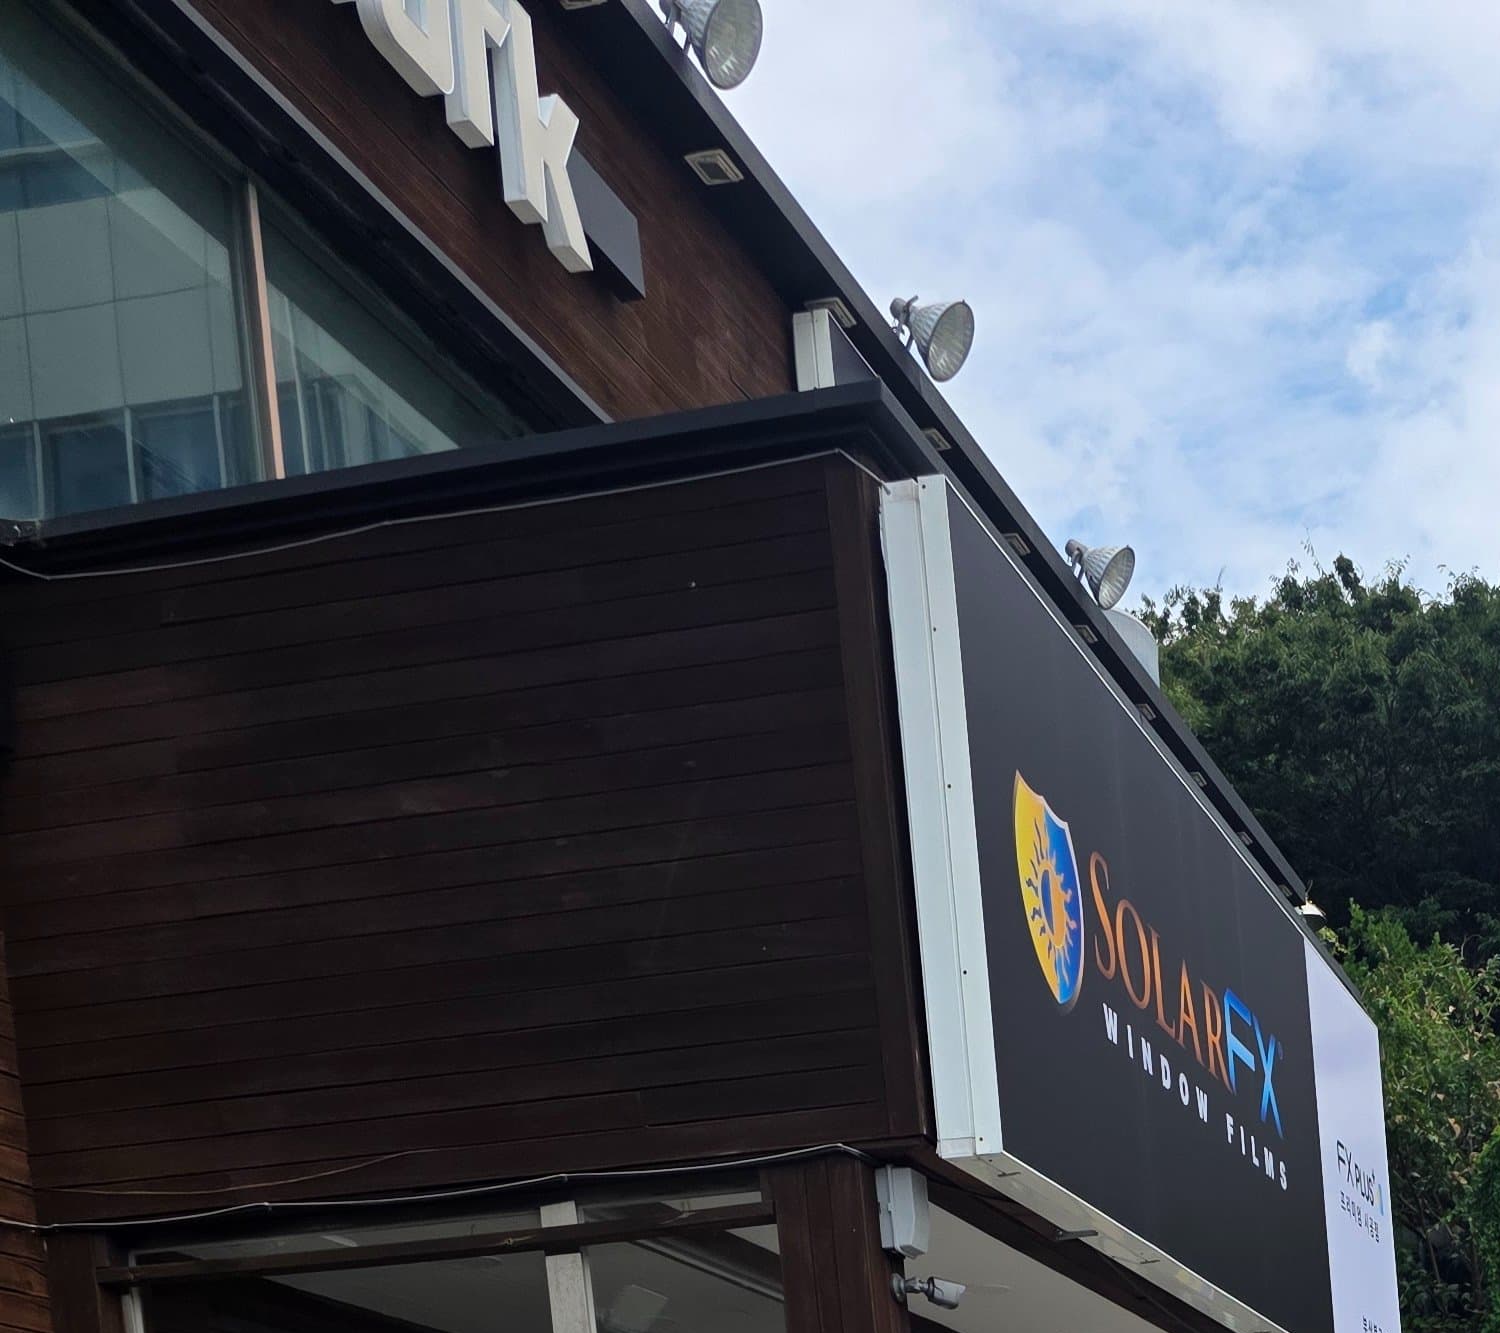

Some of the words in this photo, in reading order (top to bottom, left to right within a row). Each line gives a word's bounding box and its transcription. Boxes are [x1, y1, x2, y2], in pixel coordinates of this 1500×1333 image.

[1102, 1002, 1208, 1123] WINDOW
[1225, 1113, 1288, 1191] FILMS
[1336, 1139, 1354, 1188] FX
